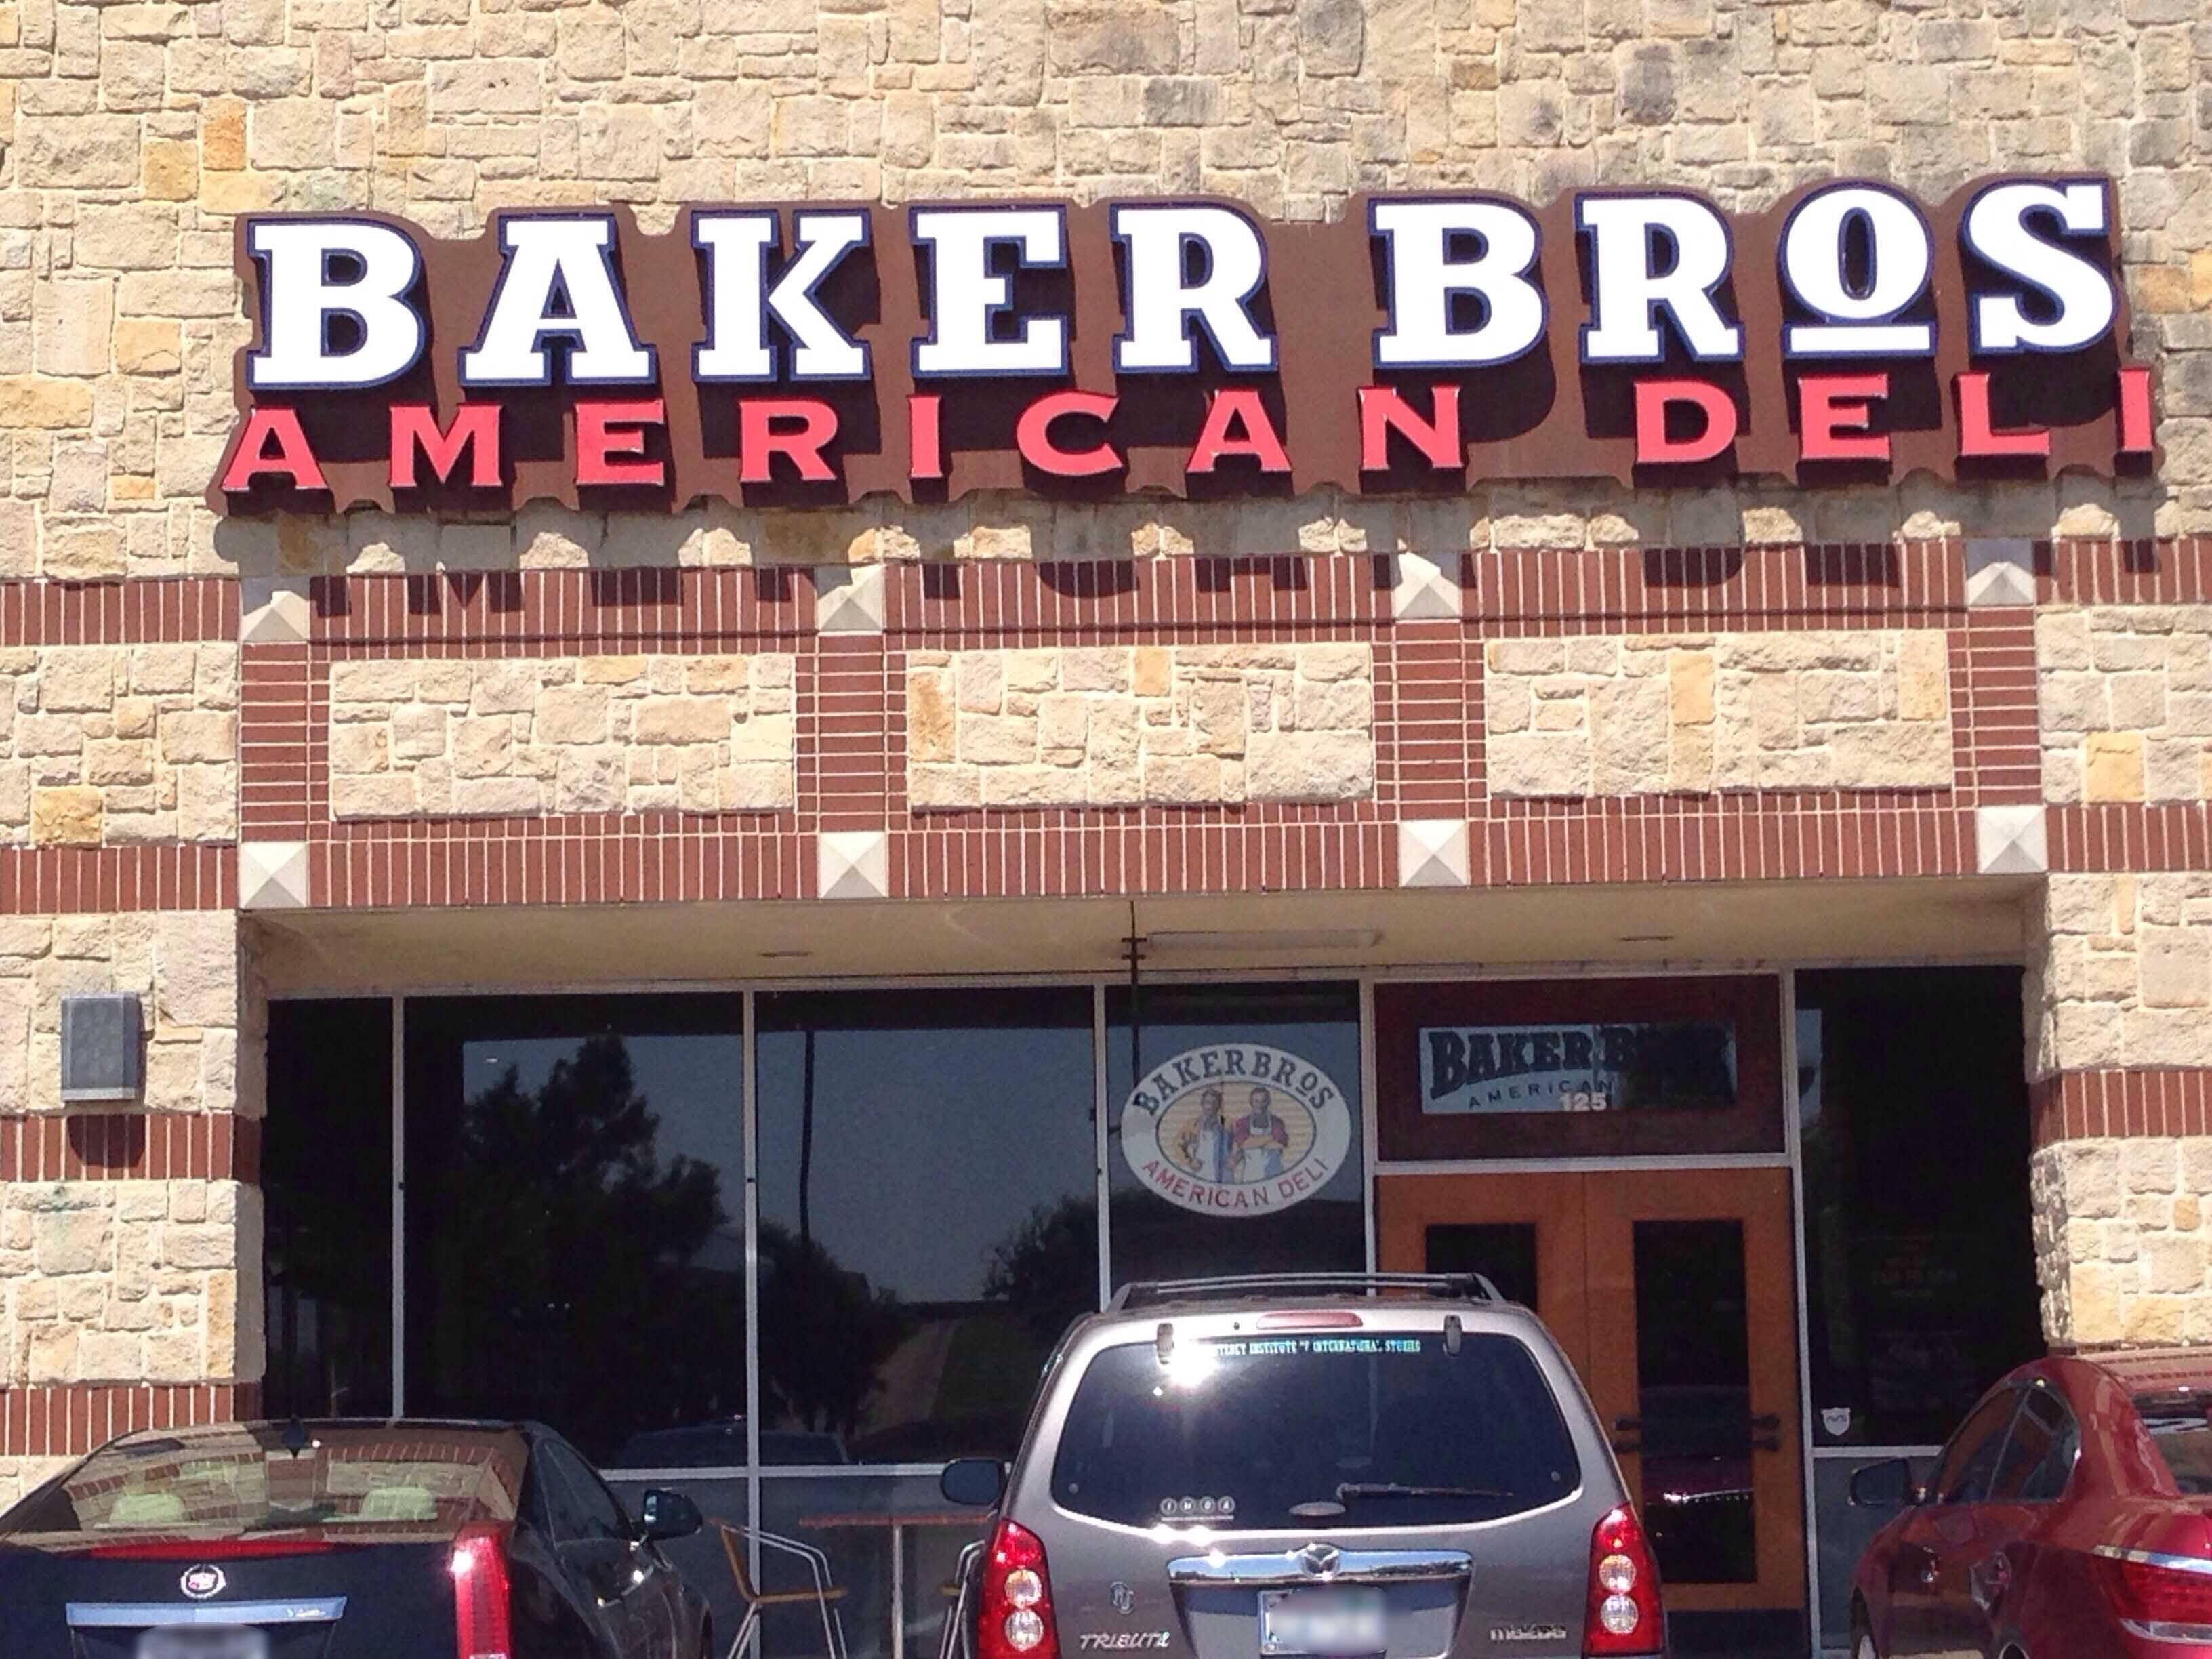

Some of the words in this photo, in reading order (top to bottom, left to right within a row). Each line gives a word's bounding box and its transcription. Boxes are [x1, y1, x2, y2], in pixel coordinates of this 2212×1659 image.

[245, 203, 1279, 390] BAKER
[1368, 177, 2119, 370] BROS
[221, 384, 1465, 492] AMERICAN
[1632, 367, 2155, 465] DELI
[1428, 1031, 1594, 1101] BAKER
[1469, 1080, 1612, 1109] AMERICAN
[1559, 1092, 1607, 1112] 125
[1143, 1160, 1269, 1208] AMERICAN
[1277, 1158, 1329, 1200] DELI
[1080, 1631, 1170, 1650] TRIBUTE
